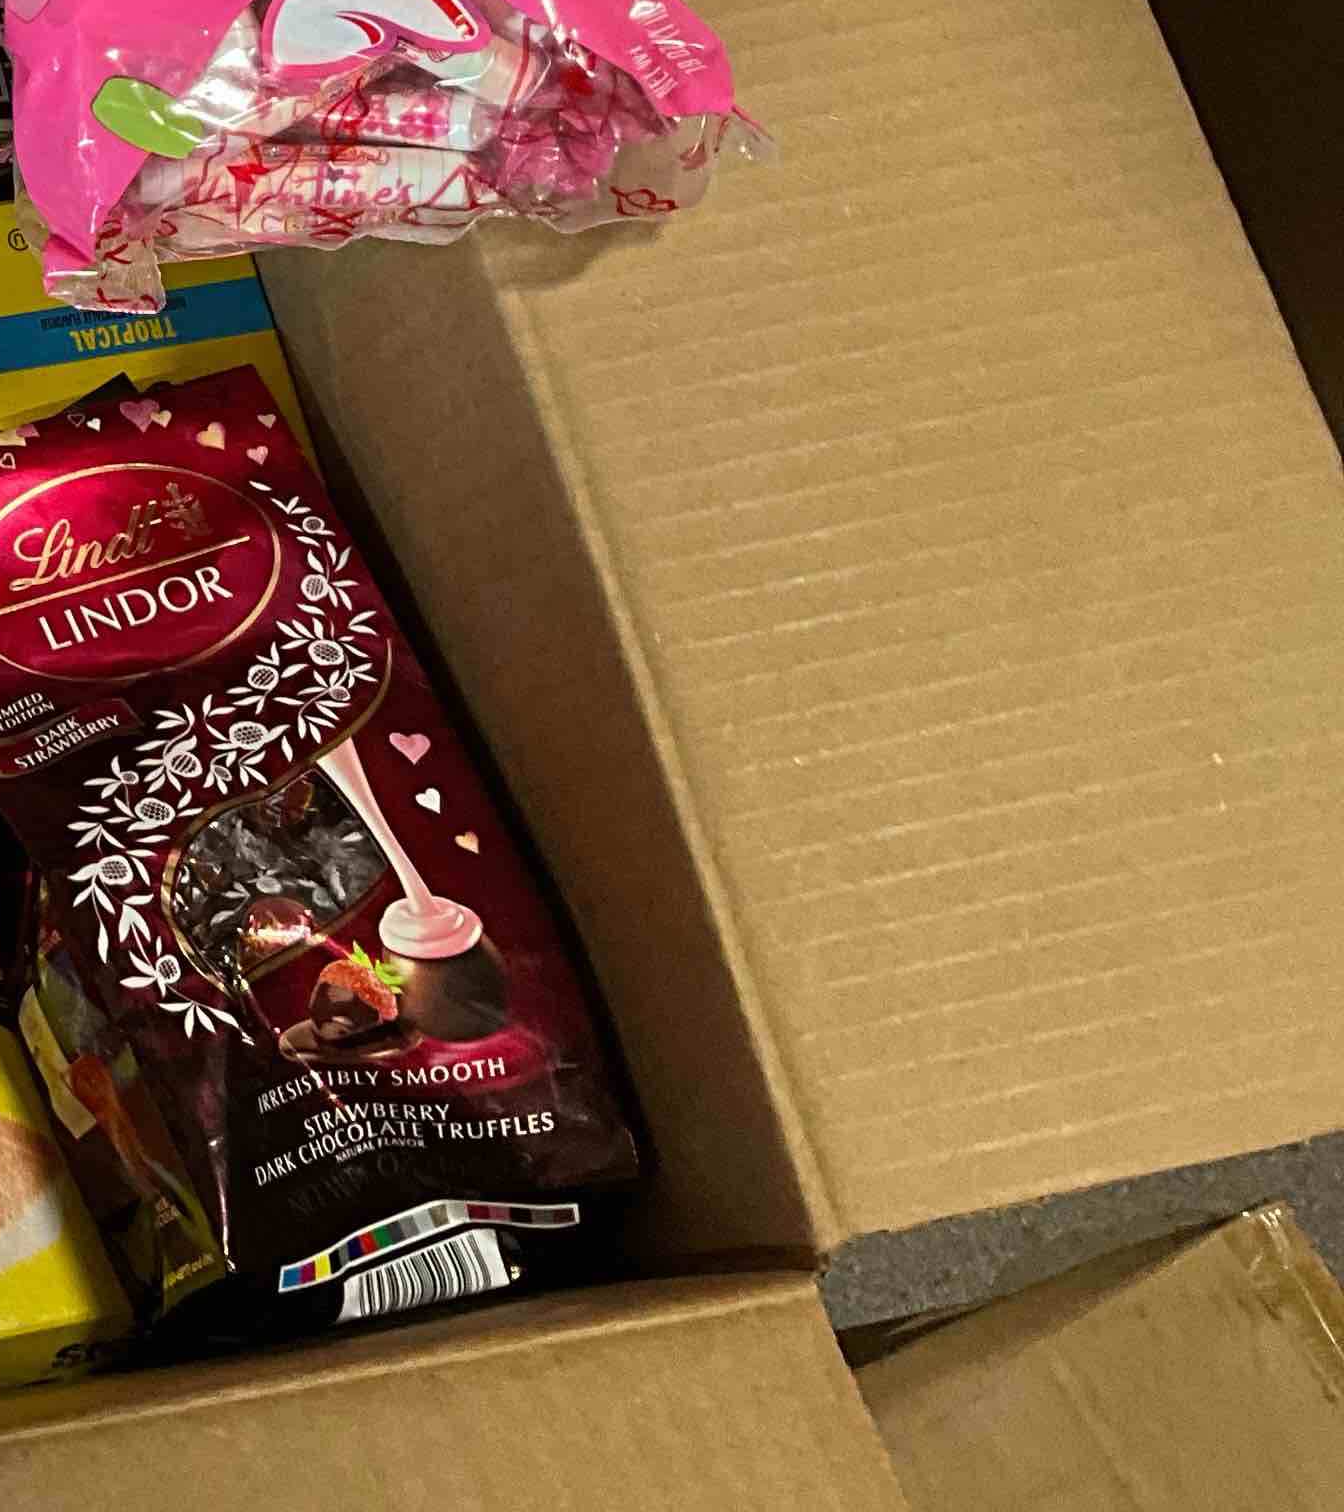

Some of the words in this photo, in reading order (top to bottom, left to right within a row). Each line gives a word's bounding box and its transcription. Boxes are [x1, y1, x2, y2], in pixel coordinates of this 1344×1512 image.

[69, 315, 178, 354] TROPICAL
[7, 498, 164, 593] Lindt
[37, 565, 235, 652] LINDOR
[13, 714, 121, 770] STRAWBERRY
[34, 715, 81, 749] DARK
[255, 1069, 381, 1116] IRRESISTIBLY
[390, 1056, 507, 1088] SMOOTH
[253, 1150, 297, 1188] DARK
[298, 1120, 426, 1167] CHOCOLATE
[432, 1110, 556, 1141] TRUFFLES
[303, 1102, 451, 1139] STRAWBERRY
